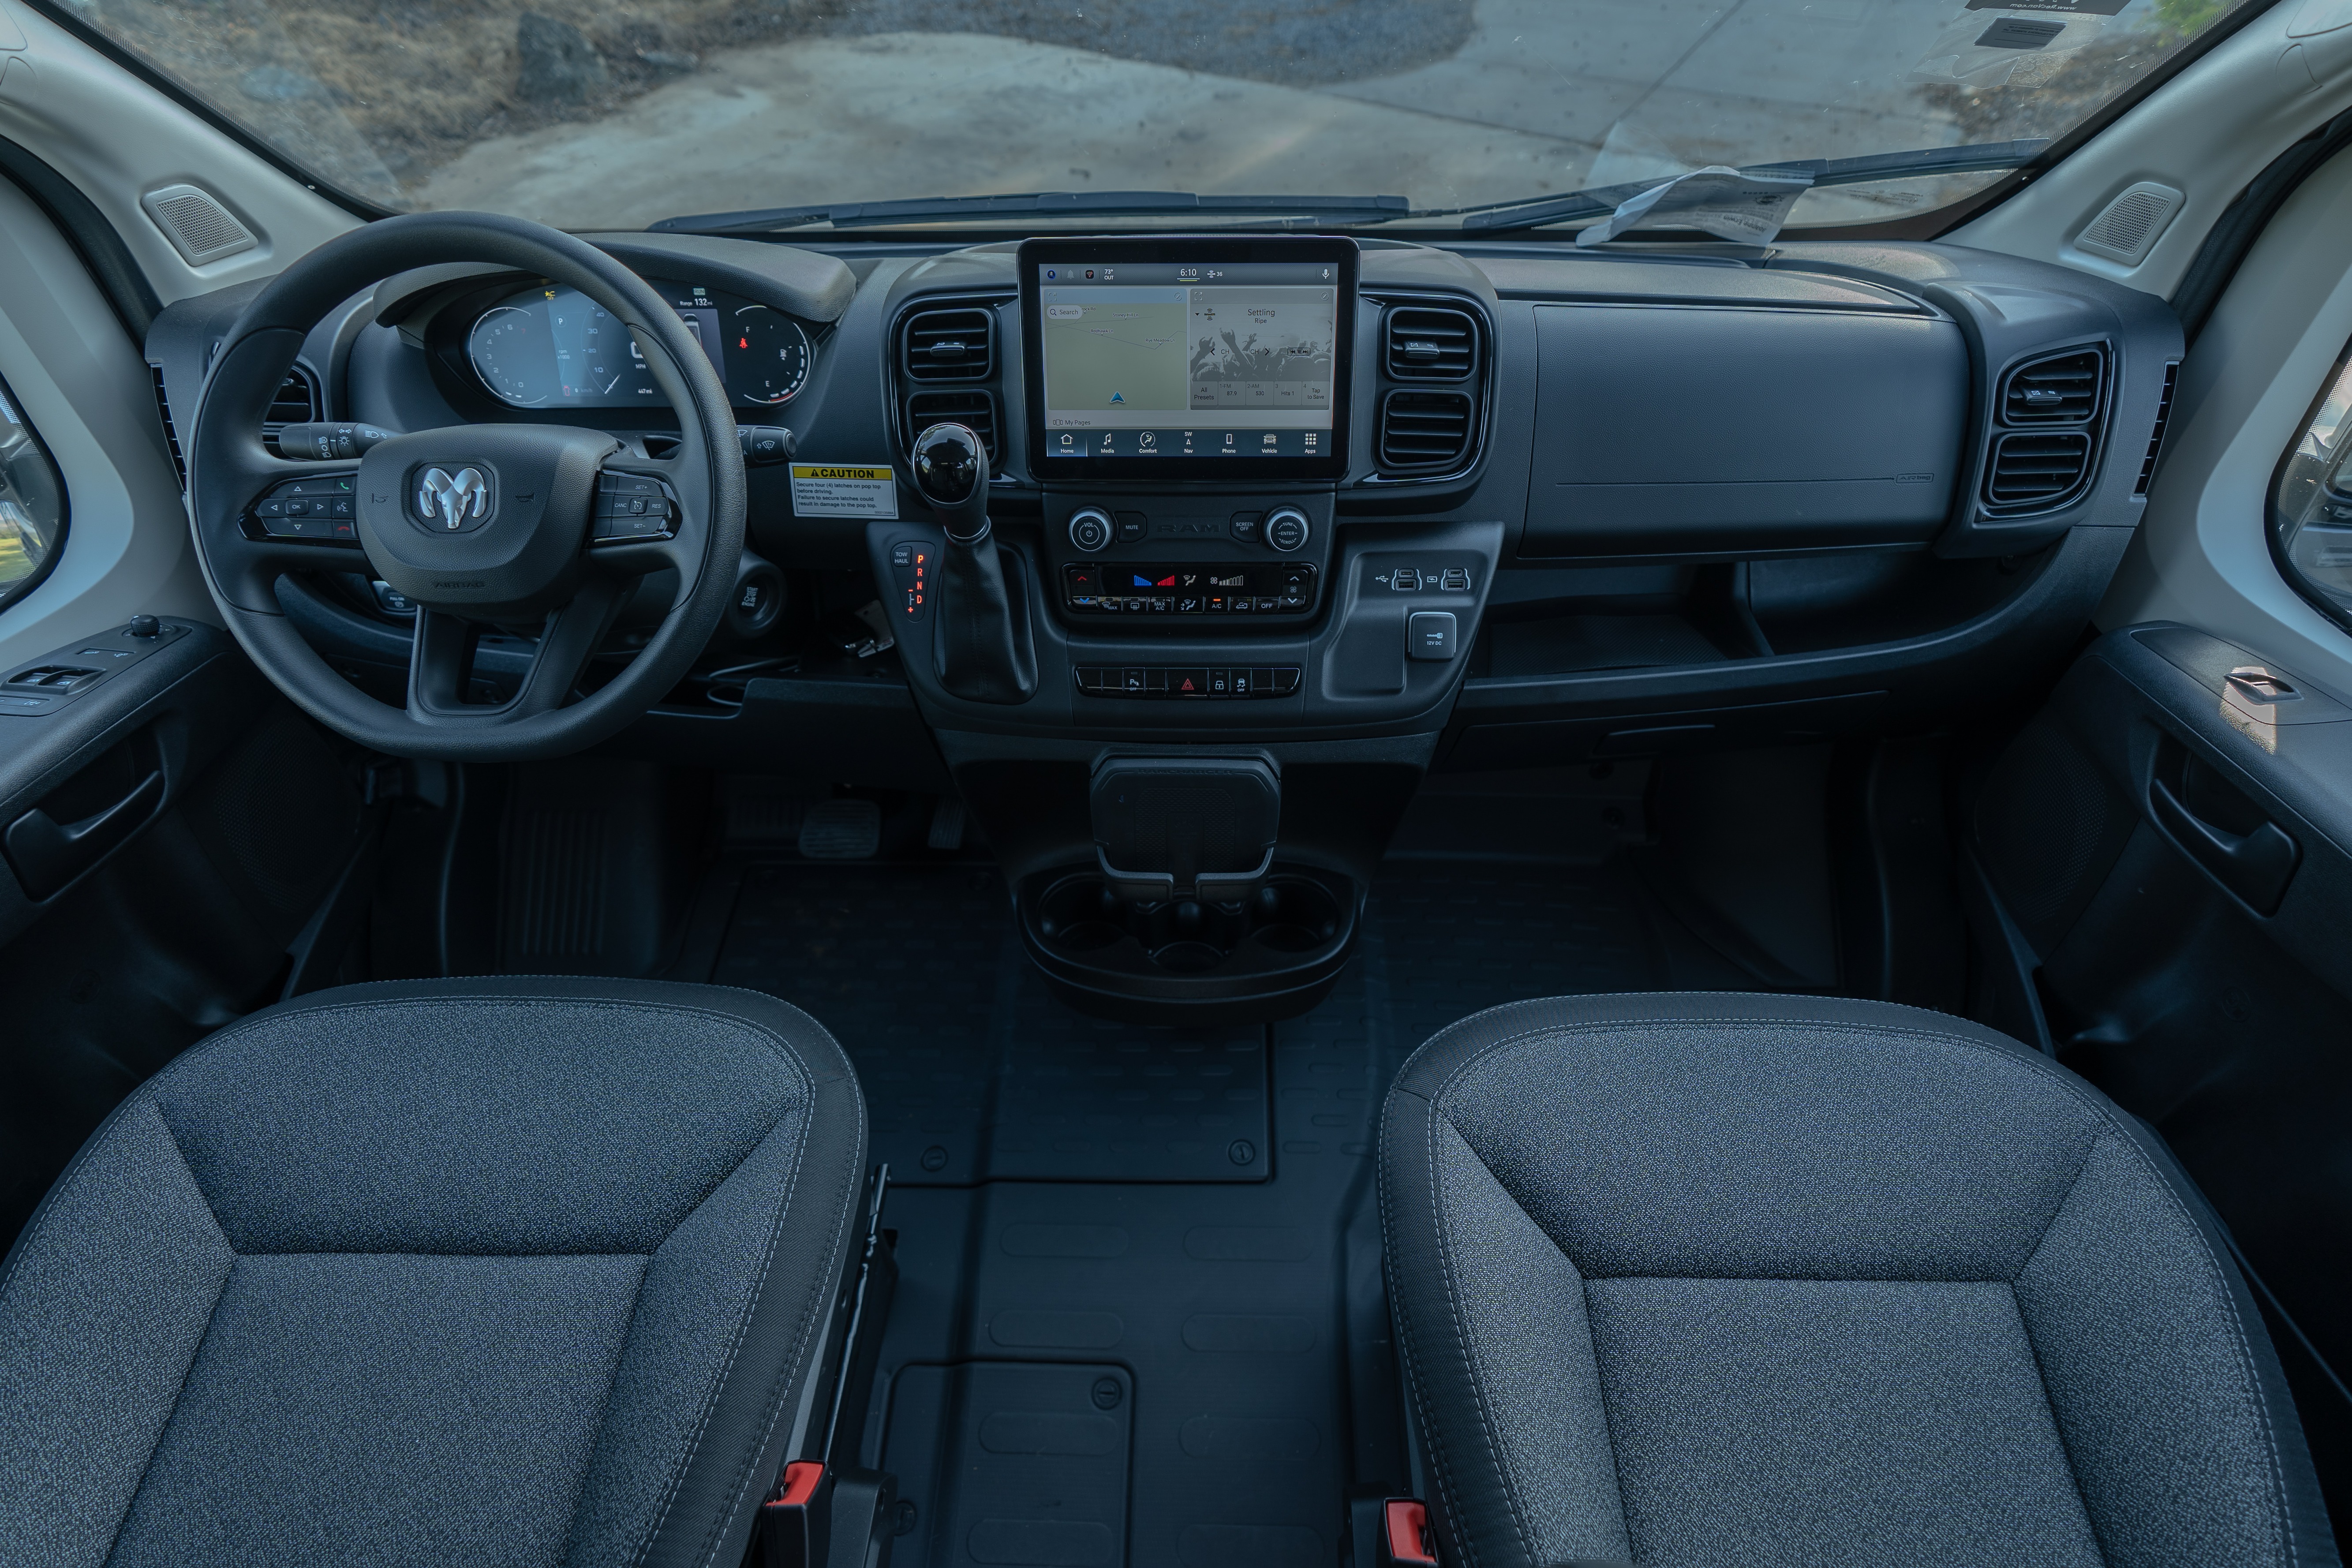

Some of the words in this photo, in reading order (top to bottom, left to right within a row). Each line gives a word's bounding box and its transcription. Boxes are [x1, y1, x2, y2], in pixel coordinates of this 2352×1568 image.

[1743, 221, 1767, 233] Joanne
[694, 298, 707, 306] 132
[1248, 309, 1275, 317] Settling
[821, 468, 874, 479] CAUTION
[918, 555, 924, 563] P
[917, 568, 923, 576] R
[917, 581, 922, 590] N
[917, 595, 922, 604] D
